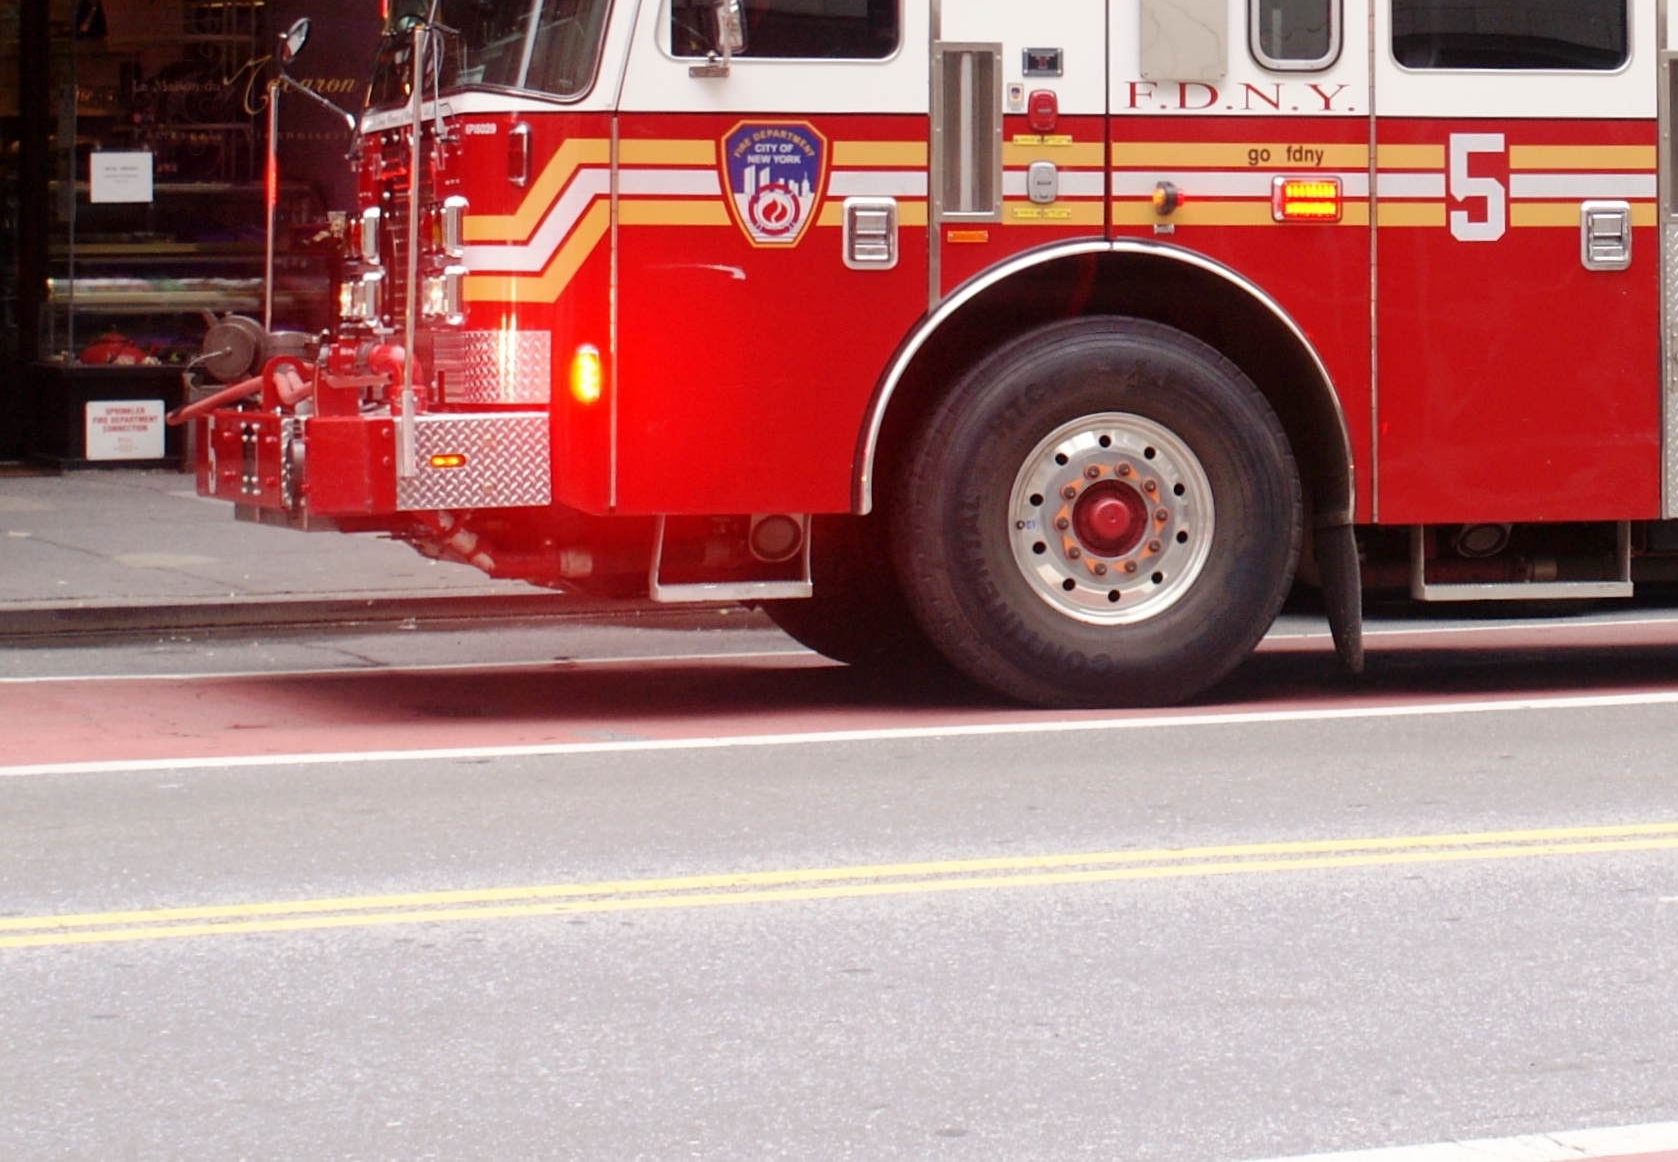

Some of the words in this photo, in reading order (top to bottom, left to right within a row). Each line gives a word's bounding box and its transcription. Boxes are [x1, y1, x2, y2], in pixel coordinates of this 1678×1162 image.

[1123, 81, 1355, 112] F.D.N.Y.
[733, 138, 752, 158] FIRE
[752, 128, 815, 157] DEPARTMENT
[754, 143, 778, 153] CITY
[779, 143, 794, 153] OF
[747, 154, 771, 164] NEW
[772, 154, 801, 164] YORK
[1248, 148, 1271, 166] go
[1286, 145, 1324, 166] fdny
[1449, 133, 1506, 241] 5
[105, 407, 145, 415] SPRINKLER
[111, 415, 158, 424] DEPARTMENT
[103, 425, 148, 433] CONNECTION
